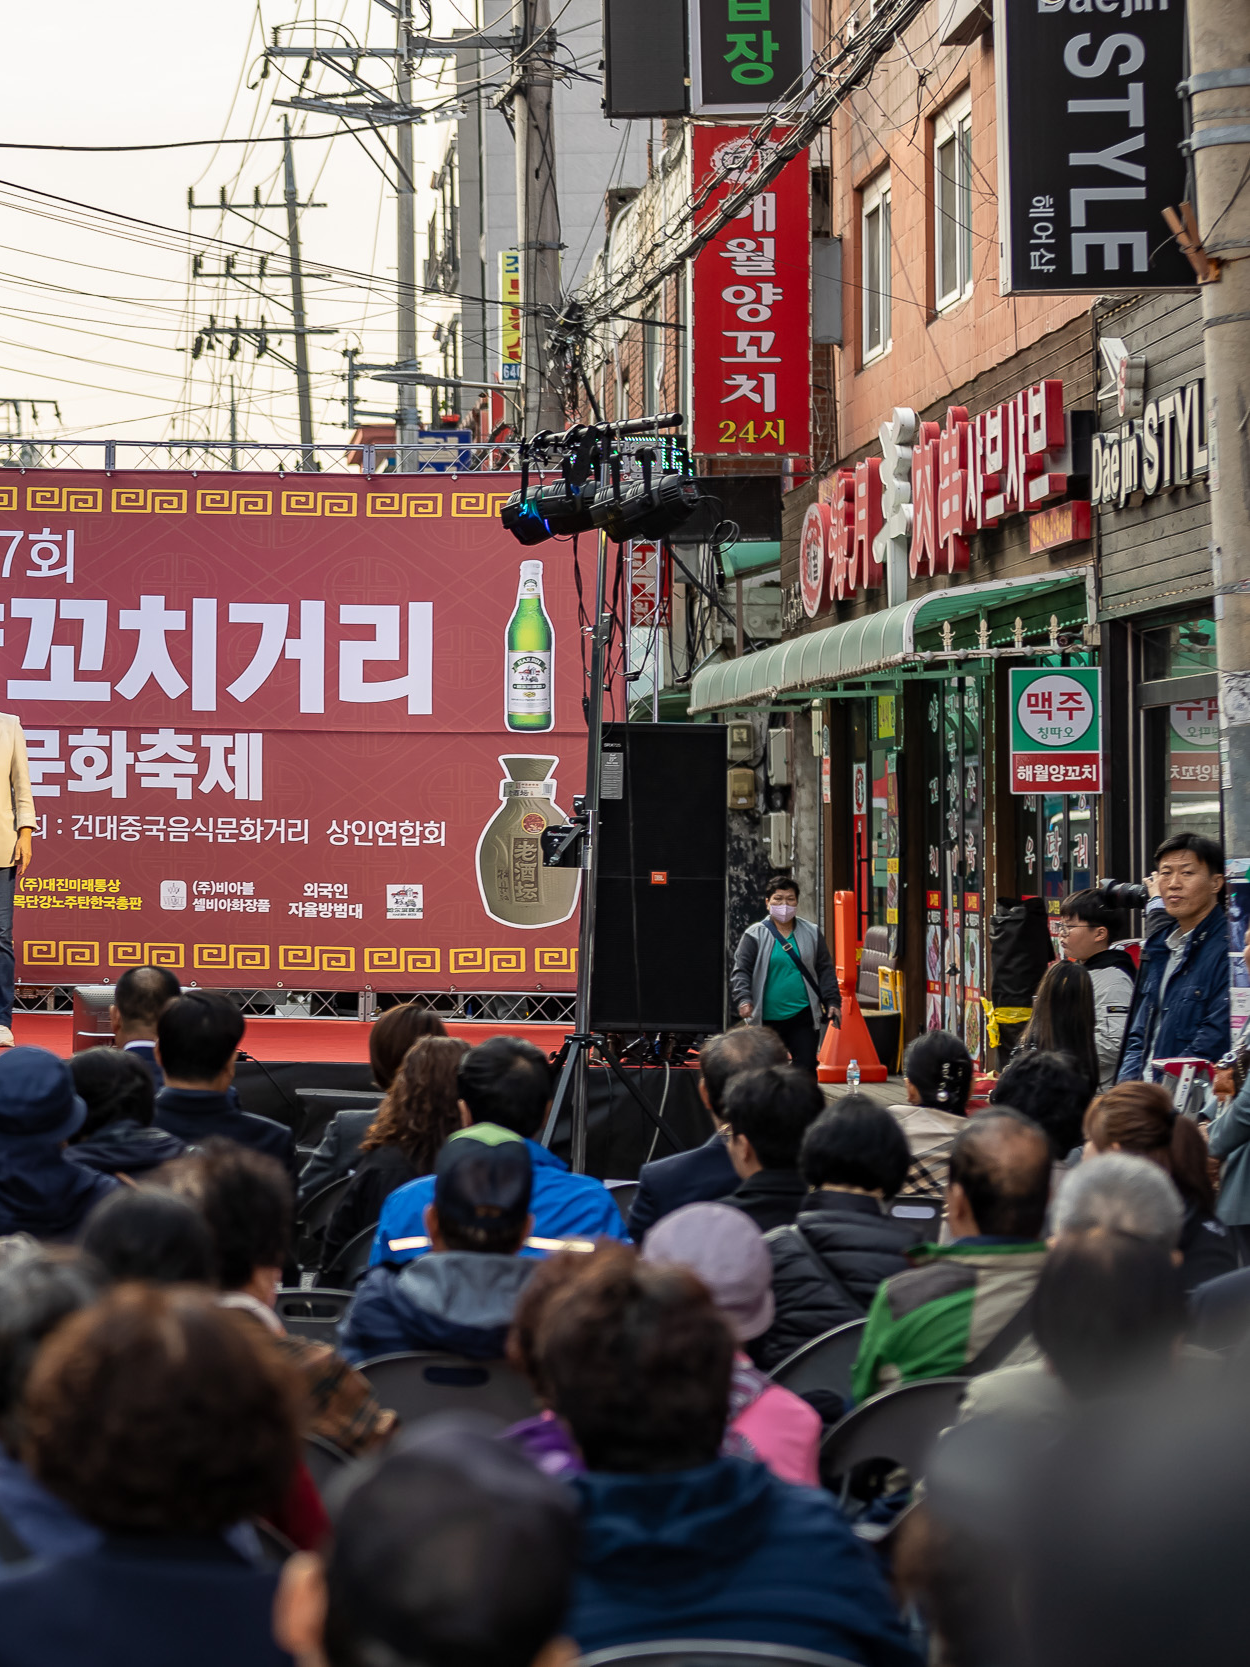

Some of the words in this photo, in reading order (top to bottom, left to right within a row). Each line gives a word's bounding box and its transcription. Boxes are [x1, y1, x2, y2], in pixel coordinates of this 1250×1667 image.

[1063, 32, 1148, 275] STYLE
[1029, 195, 1056, 273] 헤어샵
[718, 419, 785, 446] 24시
[1091, 421, 1138, 508] Daejin
[1142, 384, 1210, 496] STYL
[1026, 691, 1086, 721] 맥주
[1037, 726, 1076, 740] 칭따오
[22, 728, 263, 802] 문화축제
[1016, 764, 1098, 783] 해월양꼬치
[71, 814, 309, 844] 건대중국음식문화거리
[326, 819, 447, 847] 상인연합회
[514, 839, 538, 903] 老酒坛
[19, 877, 121, 893] (주)대진미래통상
[192, 880, 255, 896] (주)비아블
[303, 882, 349, 899] 외국인
[13, 894, 143, 910] 목단강노주탄한국총판
[192, 898, 271, 912] 셀비아화장품
[288, 901, 363, 919] 자율방범대
